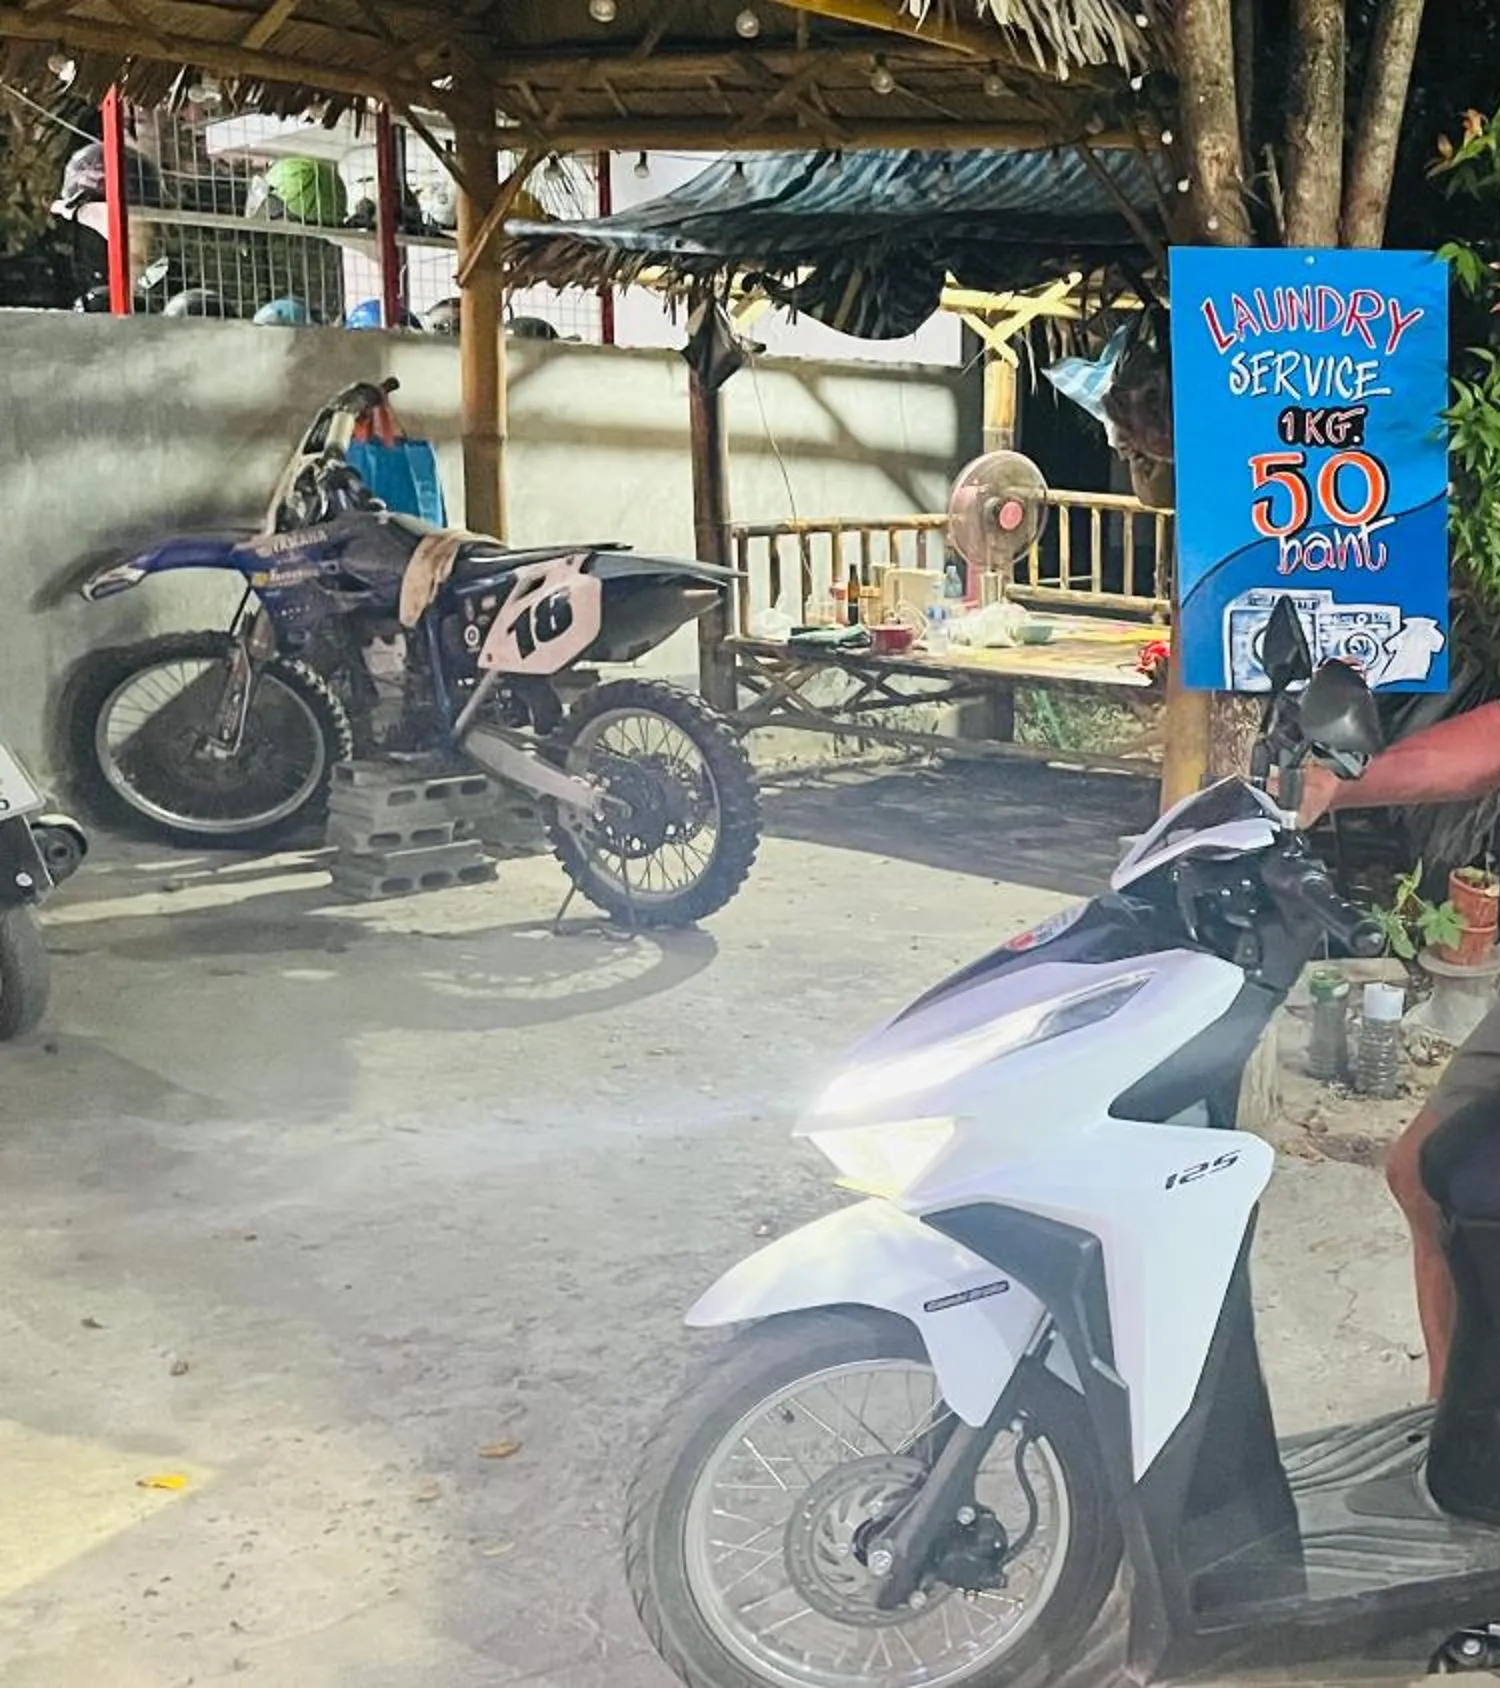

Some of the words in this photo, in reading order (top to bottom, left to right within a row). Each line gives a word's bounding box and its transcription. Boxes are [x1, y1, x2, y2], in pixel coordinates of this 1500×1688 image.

[1202, 284, 1424, 355] LAUNDRY
[1229, 349, 1392, 401] SERVICE
[1281, 411, 1295, 442] 1
[1305, 407, 1365, 444] KG.
[1249, 451, 1386, 537] 50
[1164, 1149, 1242, 1191] 125
